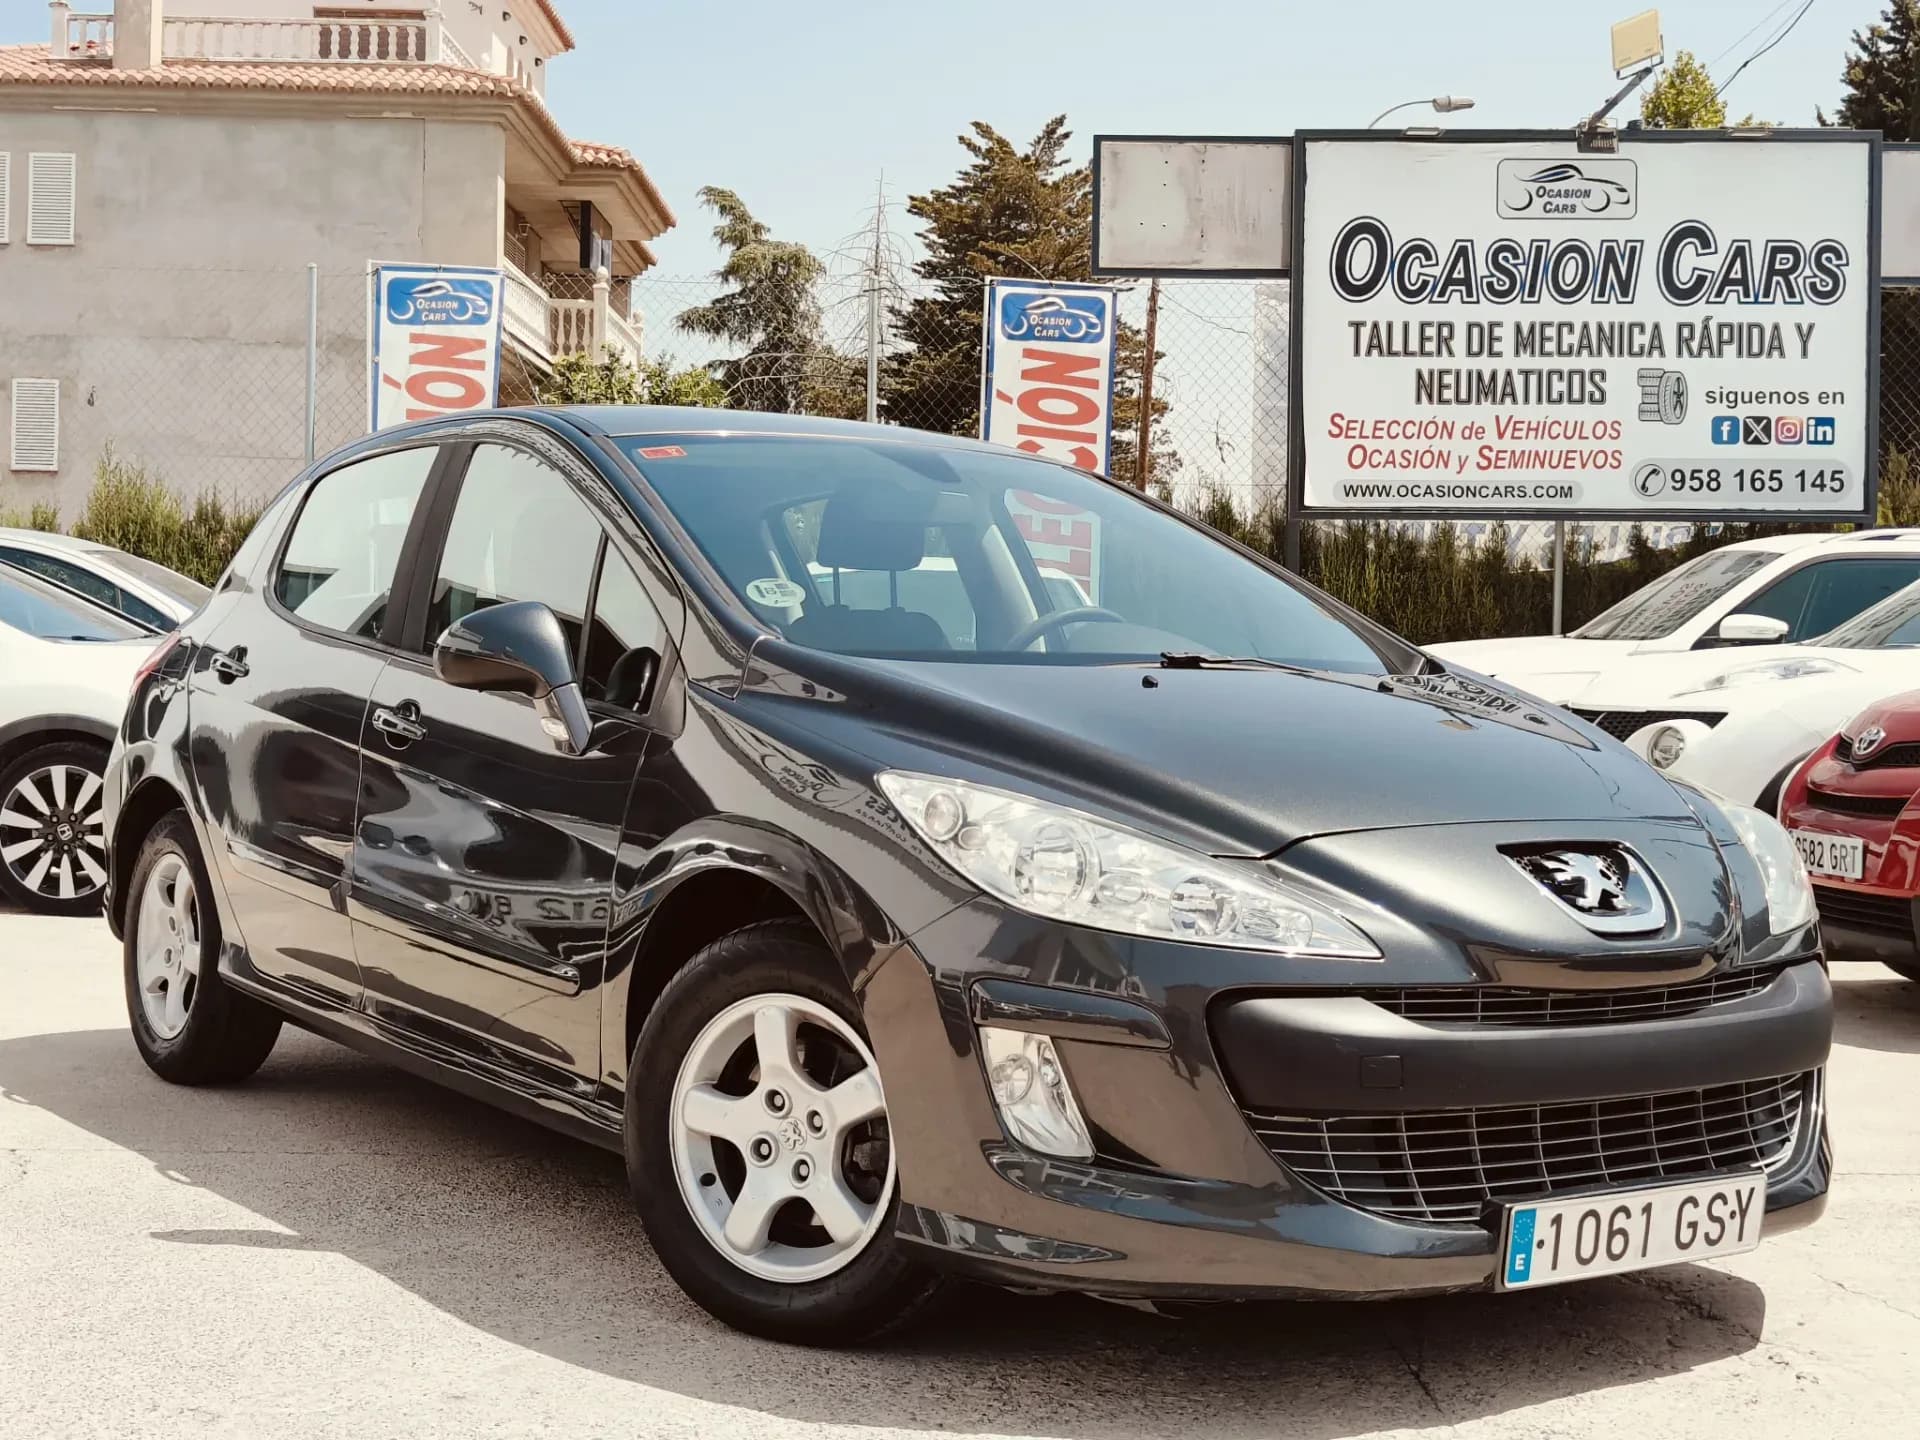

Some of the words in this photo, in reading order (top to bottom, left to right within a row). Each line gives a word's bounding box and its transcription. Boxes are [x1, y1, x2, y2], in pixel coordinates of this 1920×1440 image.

[1535, 185, 1592, 199] OCASION
[1542, 201, 1577, 214] CARS
[1329, 215, 1644, 305] OCASION
[1656, 219, 1850, 307] CARS
[416, 298, 459, 310] OCASION
[422, 311, 447, 321] CARS
[1030, 314, 1072, 327] OCASION
[1034, 326, 1060, 337] CARS
[1347, 320, 1456, 358] TALLER
[1465, 320, 1503, 358] DE
[1513, 320, 1666, 359] MECANICA
[1676, 315, 1786, 359] RÁPIDA
[1794, 322, 1816, 360] Y
[1414, 368, 1607, 405] NEUMATICOS
[1705, 386, 1810, 409] siguenos
[1817, 390, 1845, 405] en
[1328, 412, 1455, 440] SELECCIÓN
[1461, 420, 1486, 440] de
[1494, 414, 1623, 441] VEHÍCULOS
[1347, 443, 1451, 470] OCASIÓN
[1456, 454, 1469, 475] y
[1476, 444, 1623, 471] SEMINUEVOS
[1343, 484, 1574, 500] WWW.OCASIONCARS.COM
[1669, 468, 1722, 493] 958
[1733, 468, 1784, 493] 165
[1794, 468, 1845, 493] 145
[1829, 842, 1859, 873] GRT
[1549, 1202, 1653, 1271] 1061
[1674, 1186, 1756, 1251] GSY
[1514, 1253, 1527, 1271] E
